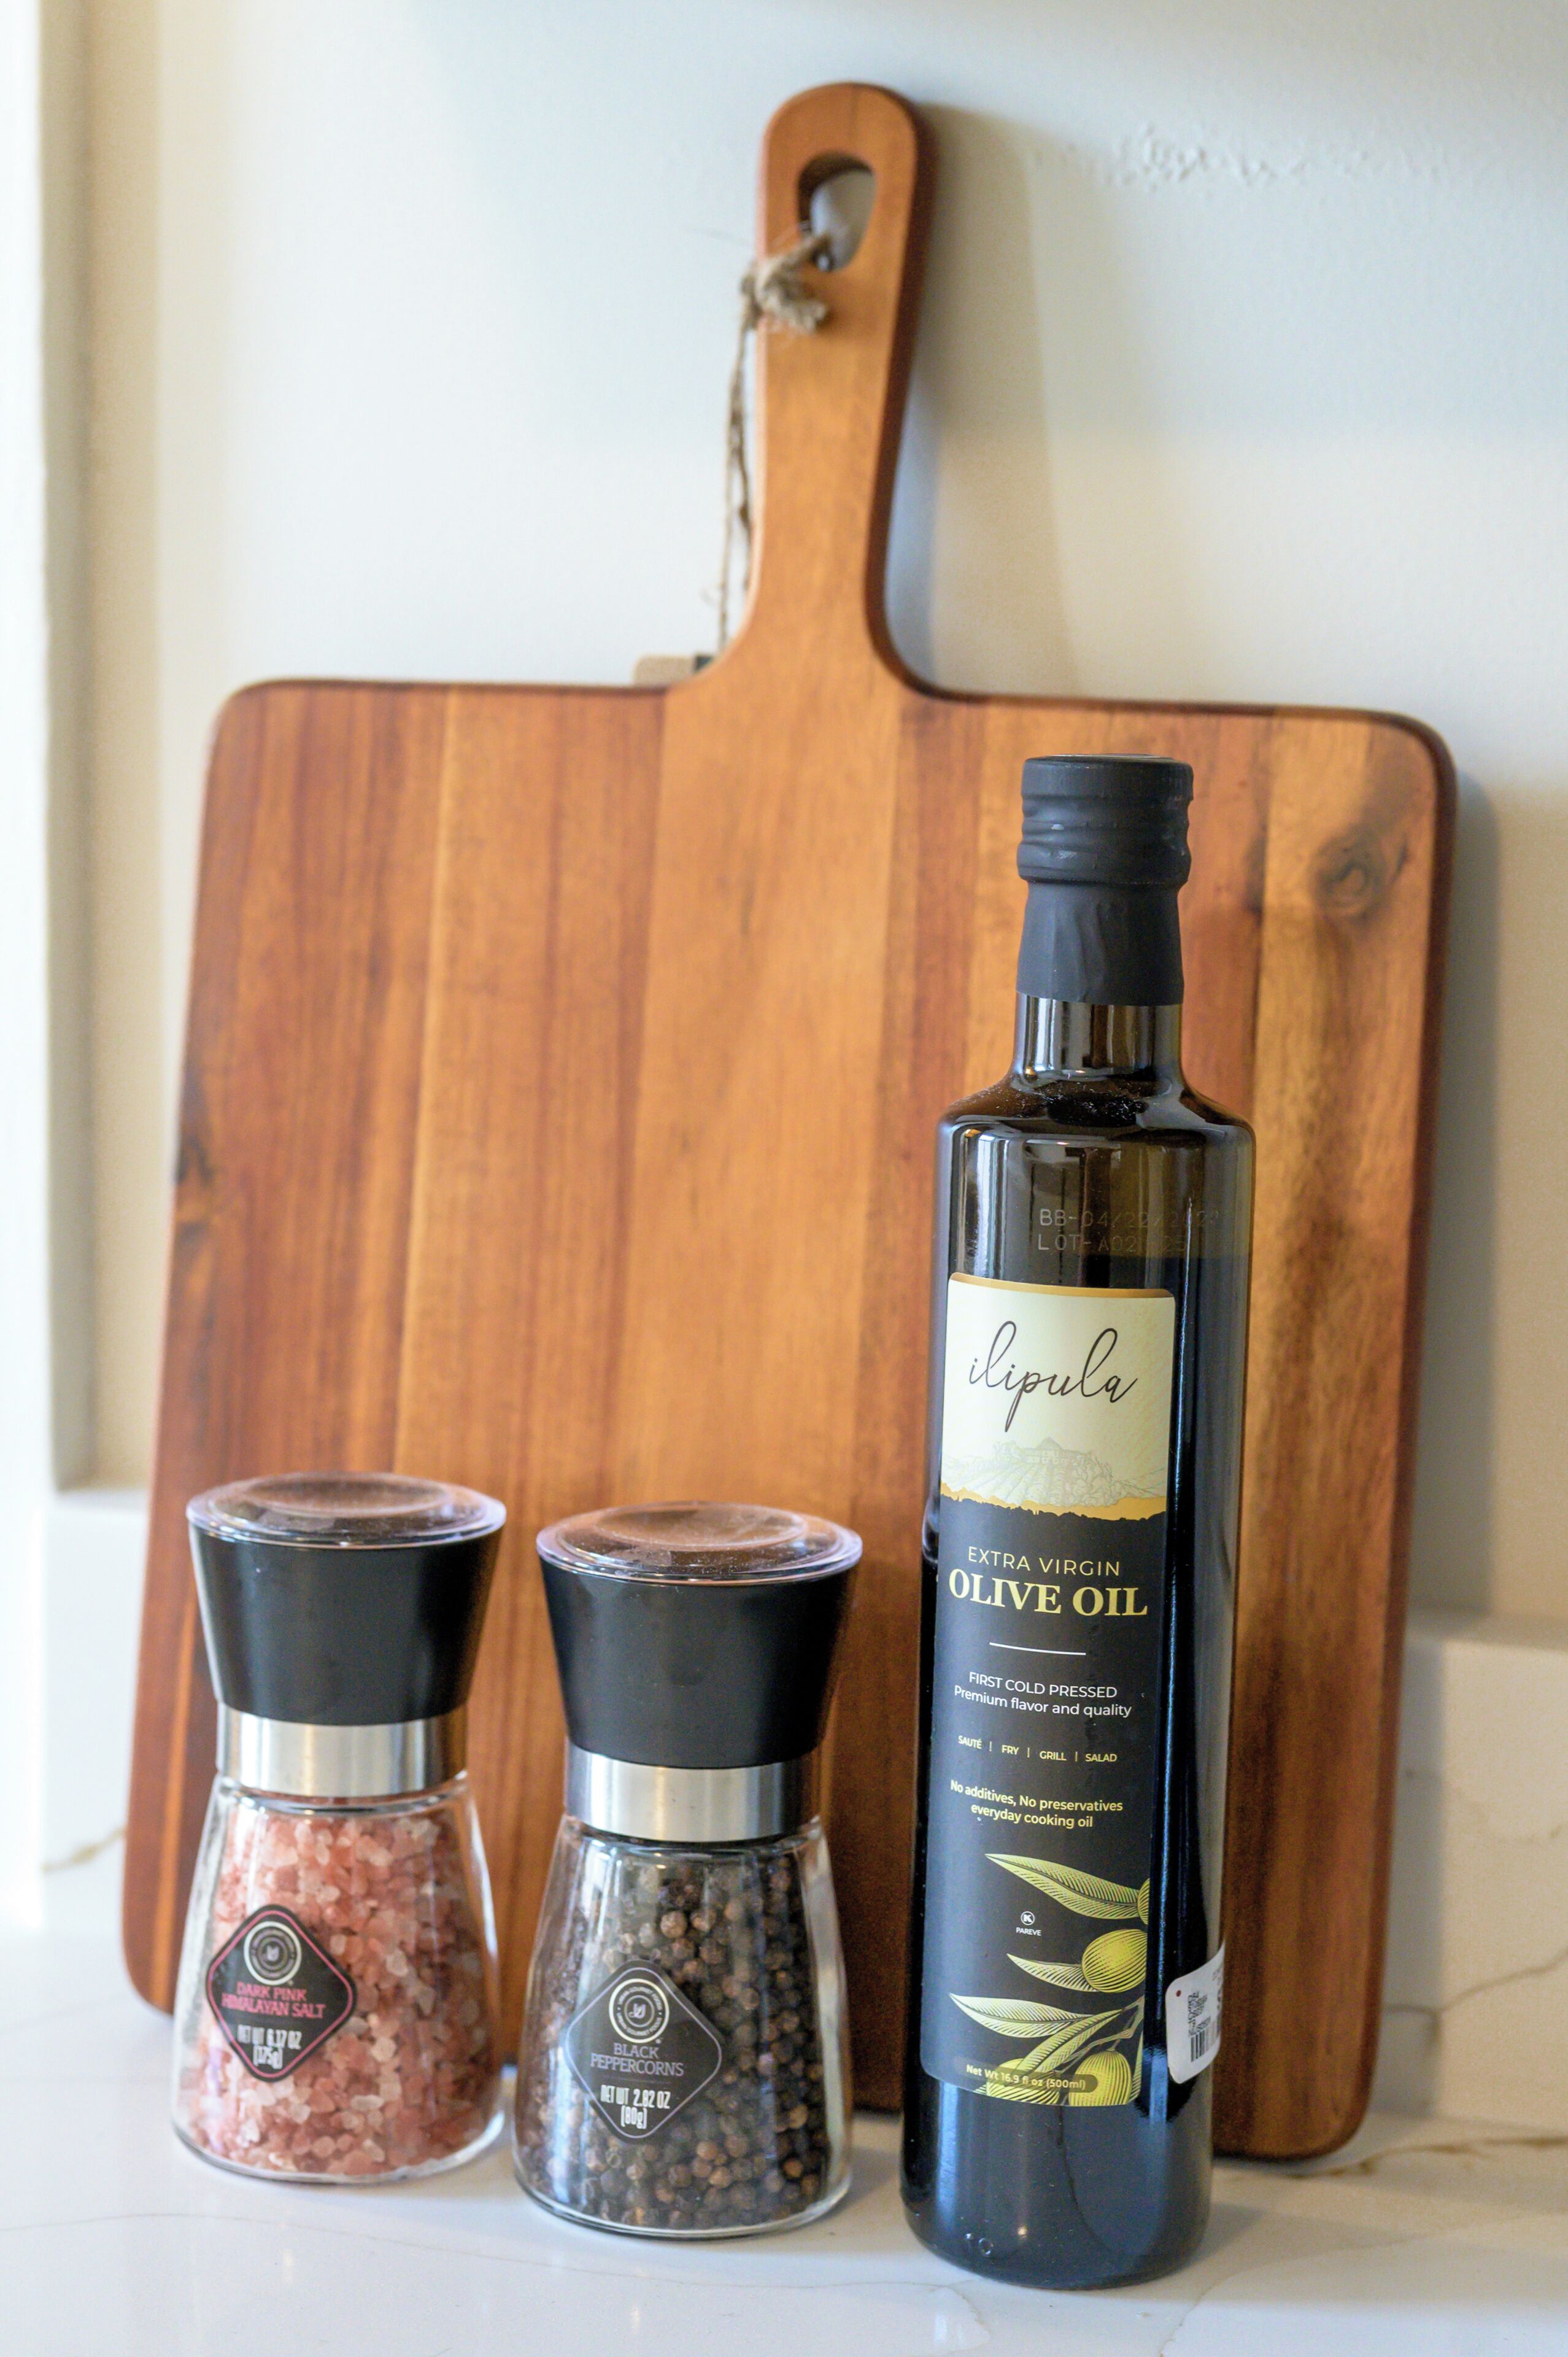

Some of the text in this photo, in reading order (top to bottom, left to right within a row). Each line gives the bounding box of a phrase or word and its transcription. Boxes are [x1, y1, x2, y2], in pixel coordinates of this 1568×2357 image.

[968, 1320, 1138, 1433] ilipula
[968, 1546, 1120, 1576] EXTRA VIRGIN
[949, 1568, 1148, 1616] OLIVE OIL
[969, 1671, 1118, 1698] FIRST COLD PRESSED
[954, 1685, 1132, 1718] Premium flavor and quality
[958, 1735, 1117, 1762] SAUTÉ FRY GRILL SALAD
[950, 1779, 1123, 1812] No additives, No preservatives
[971, 1803, 1093, 1829] everyday cooking oil
[1016, 1927, 1041, 1936] PAREVE
[236, 1981, 307, 2002] DARK PINK
[222, 1992, 326, 2019] HIMALAYAN SALT
[613, 2042, 660, 2059] BLACK
[590, 2053, 684, 2076] PEPPERCORNS
[966, 2064, 1086, 2090] Net Wt 16.9 fl oz (500ml)
[600, 2084, 616, 2103] NET
[633, 2089, 655, 2108] 2.82
[657, 2091, 671, 2109] OZ
[620, 2105, 648, 2129] (80g)
